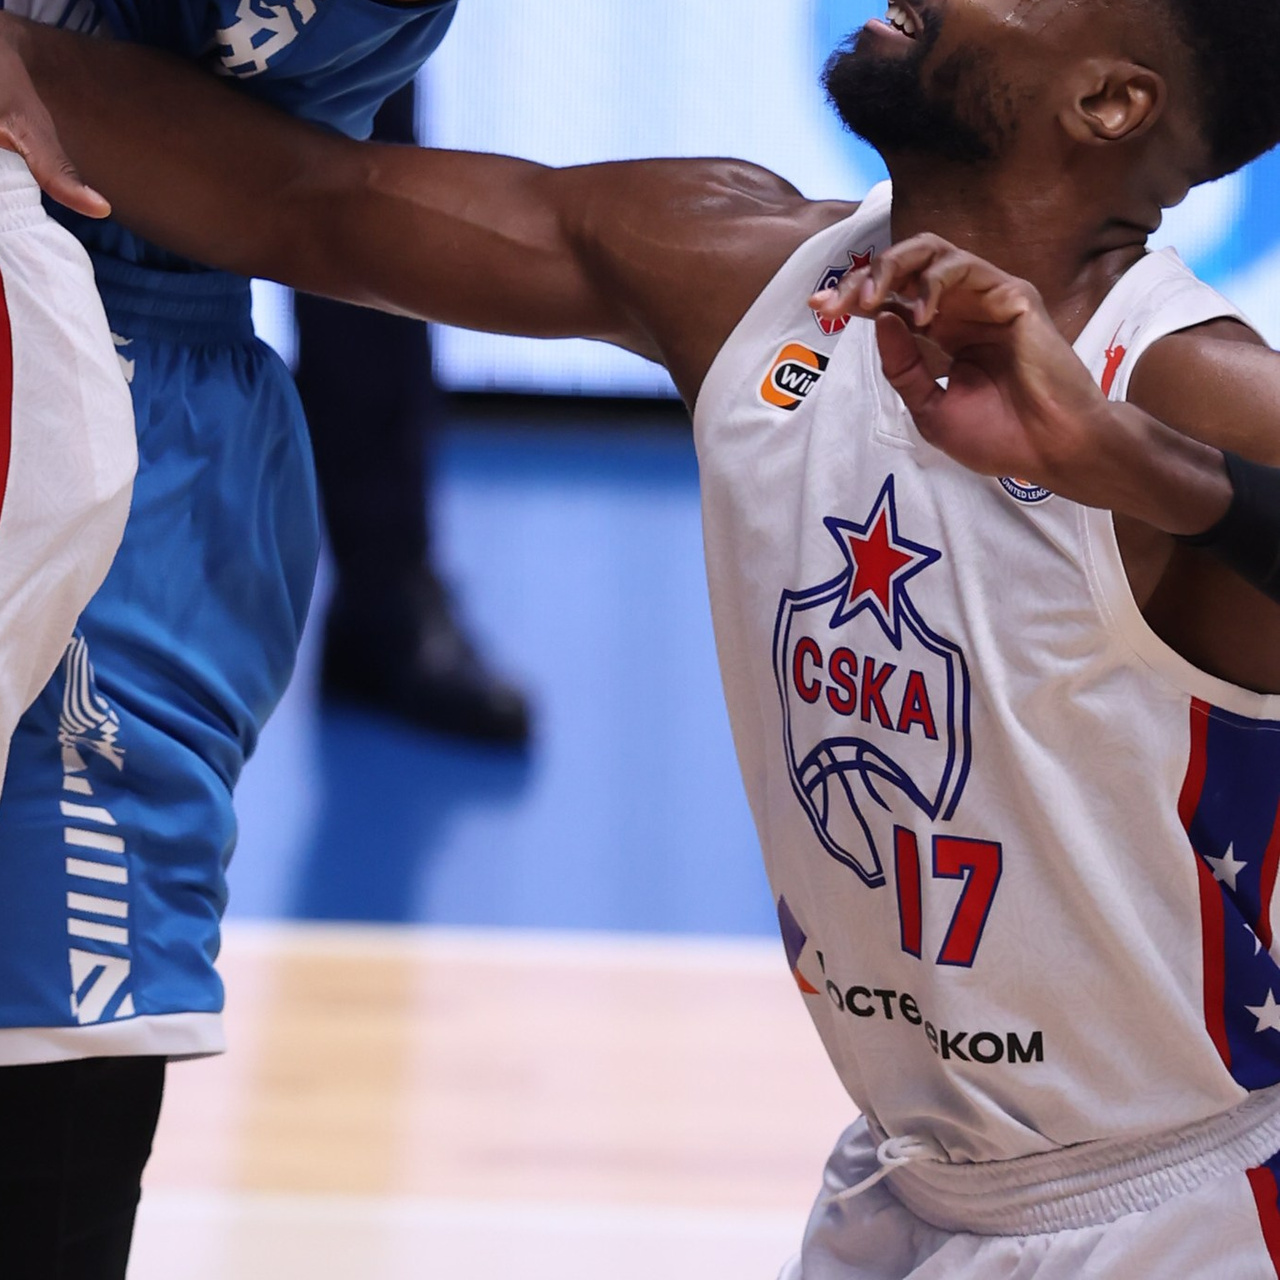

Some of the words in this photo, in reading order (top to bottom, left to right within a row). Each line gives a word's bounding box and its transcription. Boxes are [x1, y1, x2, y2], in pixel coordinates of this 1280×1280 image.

[781, 365, 816, 395] Wi
[1001, 477, 1027, 499] UNITED
[1027, 487, 1050, 500] LEAG
[792, 636, 939, 740] CSKA
[893, 824, 1003, 968] 17
